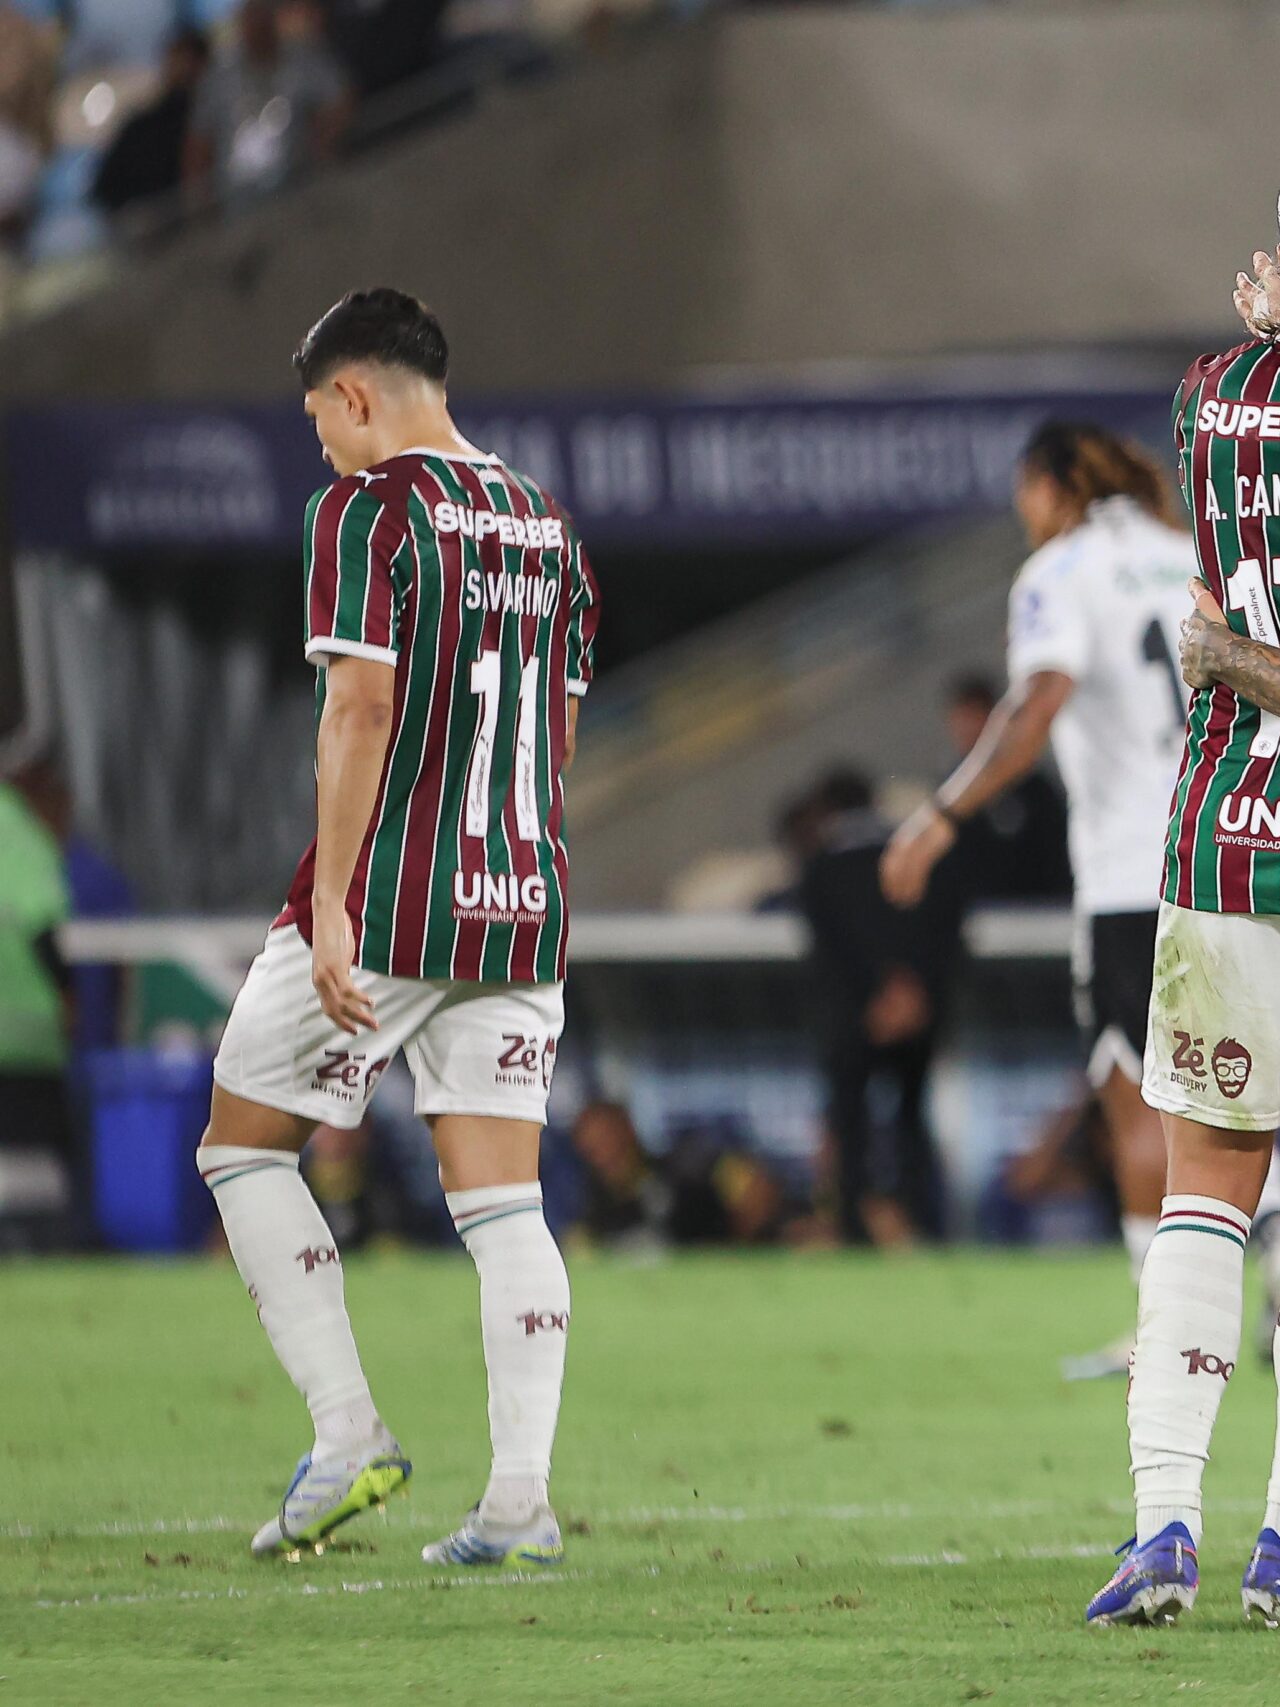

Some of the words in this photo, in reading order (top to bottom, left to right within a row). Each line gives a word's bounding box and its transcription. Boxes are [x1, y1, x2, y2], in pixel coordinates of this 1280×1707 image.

[1205, 478, 1228, 521] A.
[466, 569, 557, 619] SVARINO
[1249, 587, 1266, 638] predialnet
[466, 650, 541, 842] 11
[454, 871, 547, 913] UNIG
[498, 1033, 538, 1072] Zé
[1172, 1030, 1208, 1077] Zé
[1170, 1071, 1208, 1093] DELIVERY
